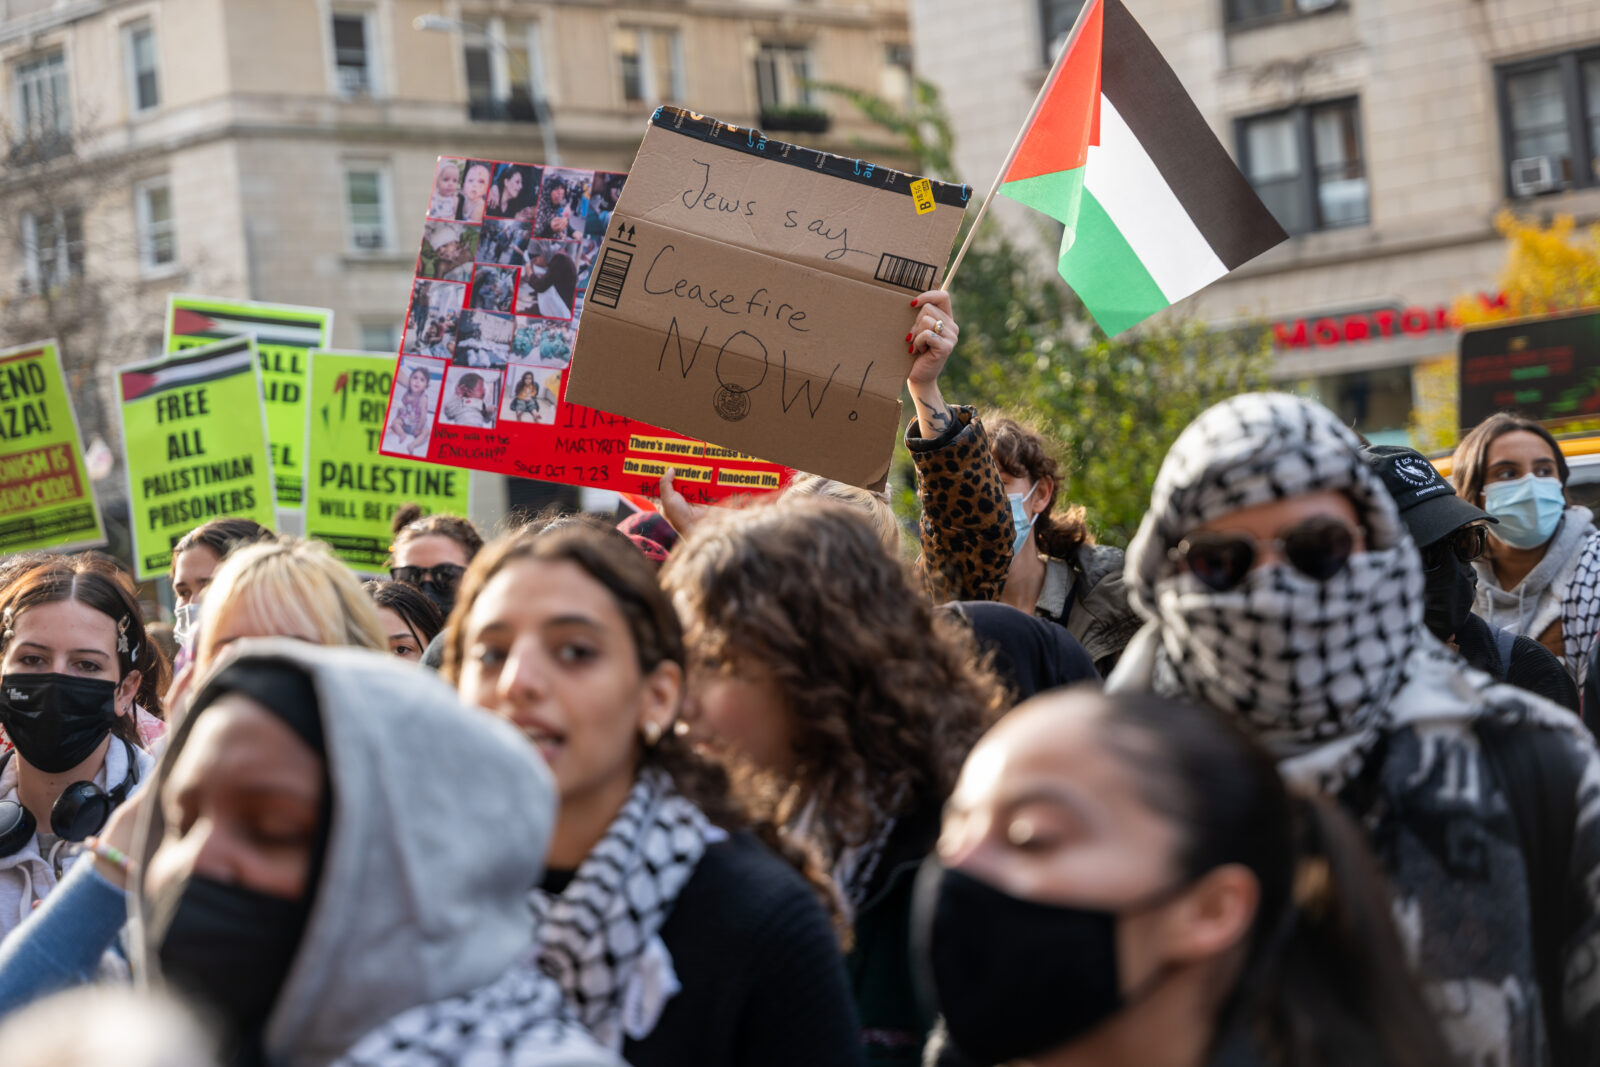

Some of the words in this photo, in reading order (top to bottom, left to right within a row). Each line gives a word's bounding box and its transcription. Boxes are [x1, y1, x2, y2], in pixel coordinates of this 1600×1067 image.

[682, 158, 756, 216] Jews
[784, 210, 879, 260] say
[920, 201, 932, 210] B
[658, 317, 875, 422] NOW!
[262, 381, 301, 404] ID
[156, 388, 210, 425] FREE
[167, 427, 207, 462] ALL
[365, 428, 380, 453] T
[555, 435, 627, 456] MARTYRED
[630, 437, 663, 451] There's
[664, 442, 691, 455] never
[692, 445, 704, 458] an
[705, 445, 738, 458] excuse
[143, 455, 255, 499] PALESTINIAN
[319, 460, 457, 498] PALESTINE
[514, 459, 542, 476] SINCE
[545, 464, 566, 478] OCT
[624, 461, 639, 472] the
[641, 463, 666, 475] mass
[674, 467, 702, 480] urder
[702, 470, 713, 481] of
[147, 486, 257, 531] PRISONERS
[319, 498, 358, 520] WILL
[363, 501, 381, 522] BE
